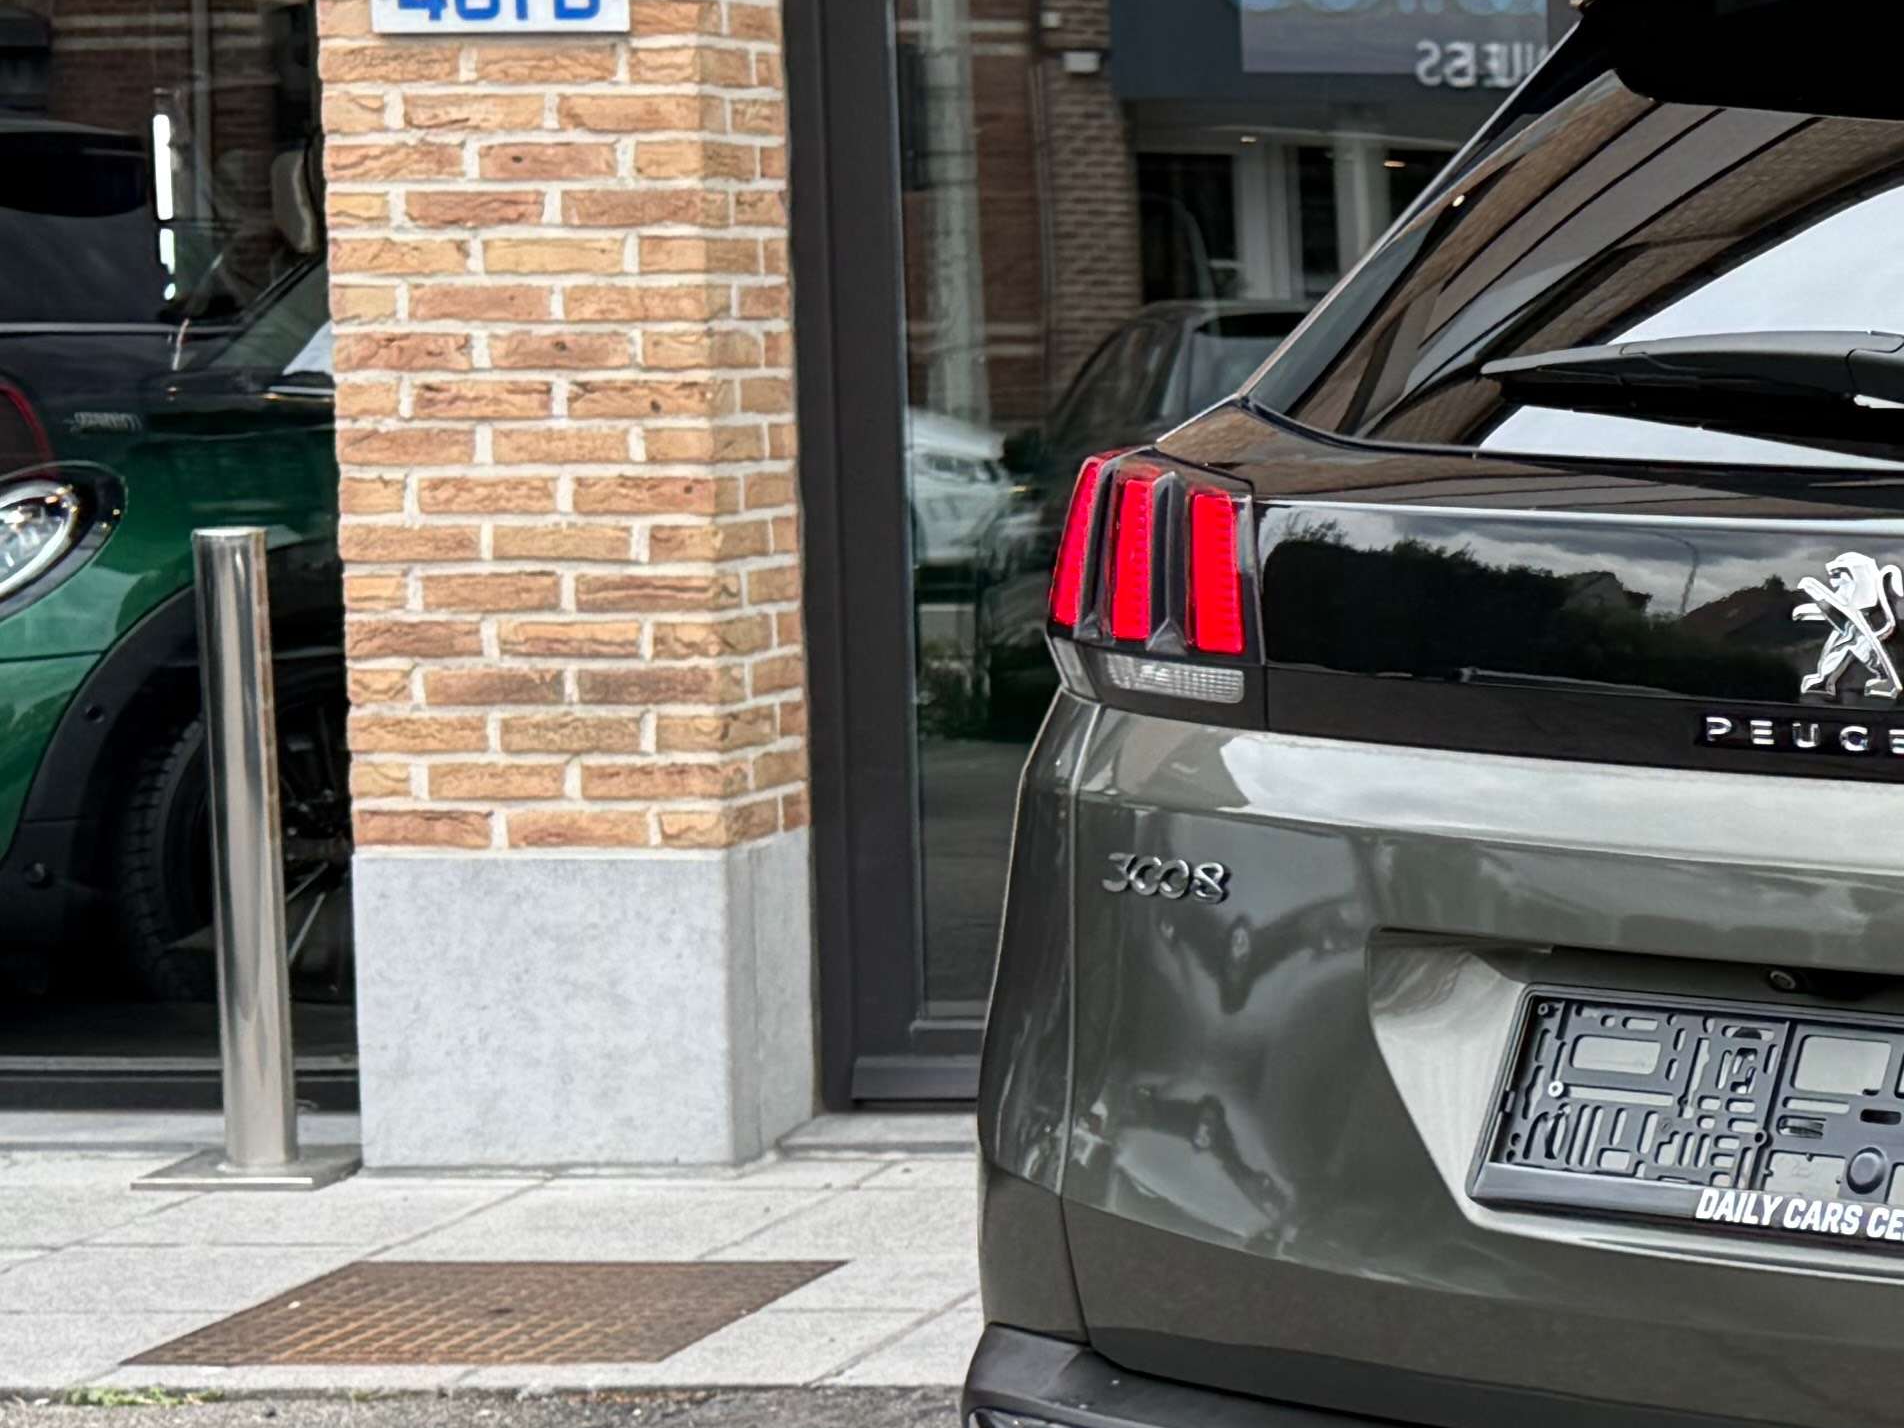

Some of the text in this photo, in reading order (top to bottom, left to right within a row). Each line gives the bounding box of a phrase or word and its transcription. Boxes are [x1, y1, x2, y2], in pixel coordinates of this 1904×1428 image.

[1101, 851, 1226, 905] 3008
[1695, 1187, 1784, 1227] DAILY
[1782, 1197, 1864, 1236] CARS
